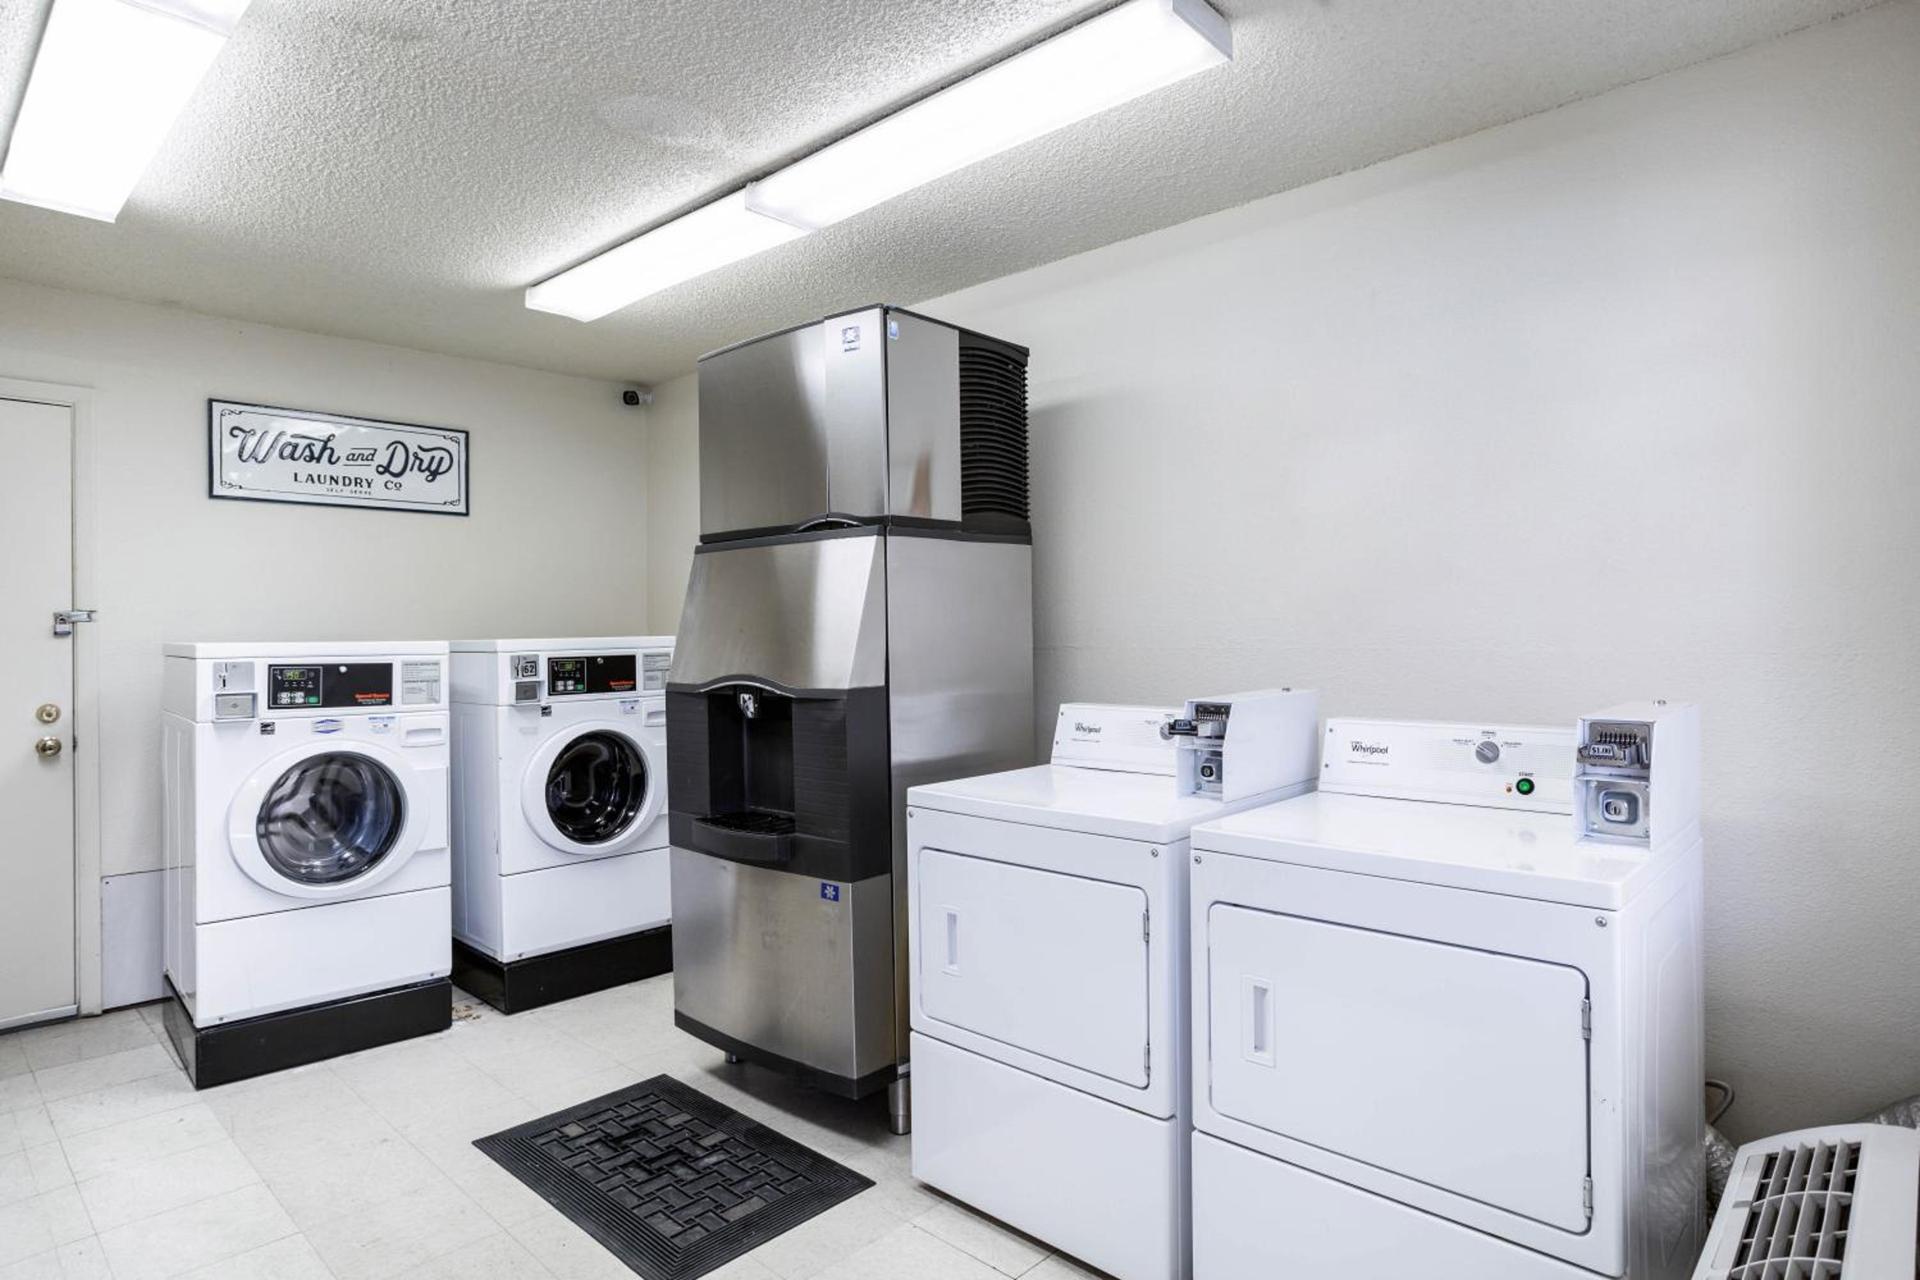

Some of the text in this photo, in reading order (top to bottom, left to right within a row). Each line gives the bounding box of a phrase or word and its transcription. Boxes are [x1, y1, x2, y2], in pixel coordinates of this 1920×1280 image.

[229, 426, 454, 483] Wash and Dry
[293, 472, 374, 489] LAUNDRY
[1351, 743, 1389, 756] Whirlpool
